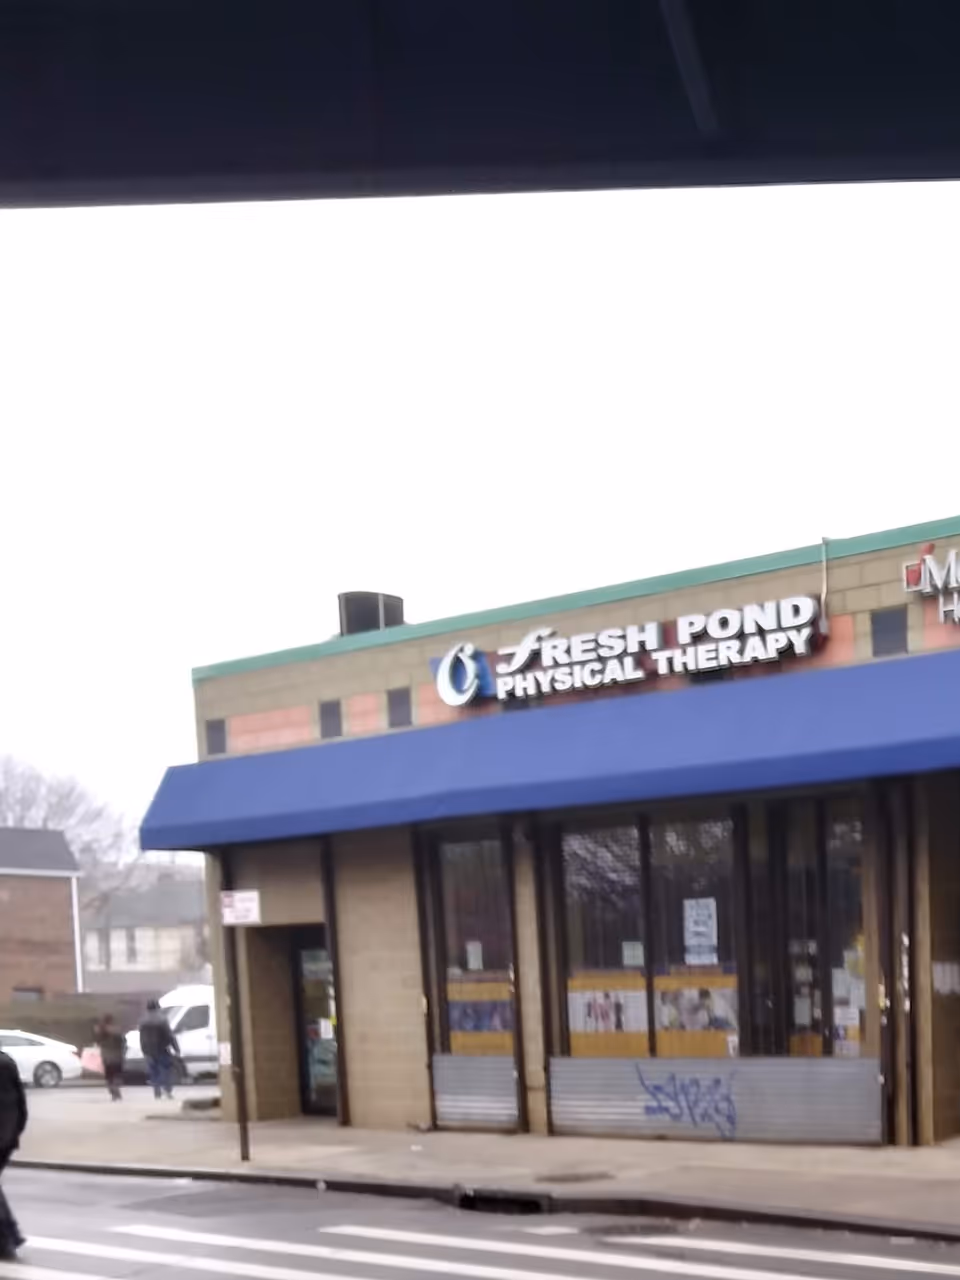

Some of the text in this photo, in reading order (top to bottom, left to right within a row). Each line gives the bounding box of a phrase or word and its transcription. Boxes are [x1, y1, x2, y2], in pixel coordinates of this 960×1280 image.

[676, 596, 818, 646] POND
[495, 627, 813, 700] PHYSICAL THERAPY
